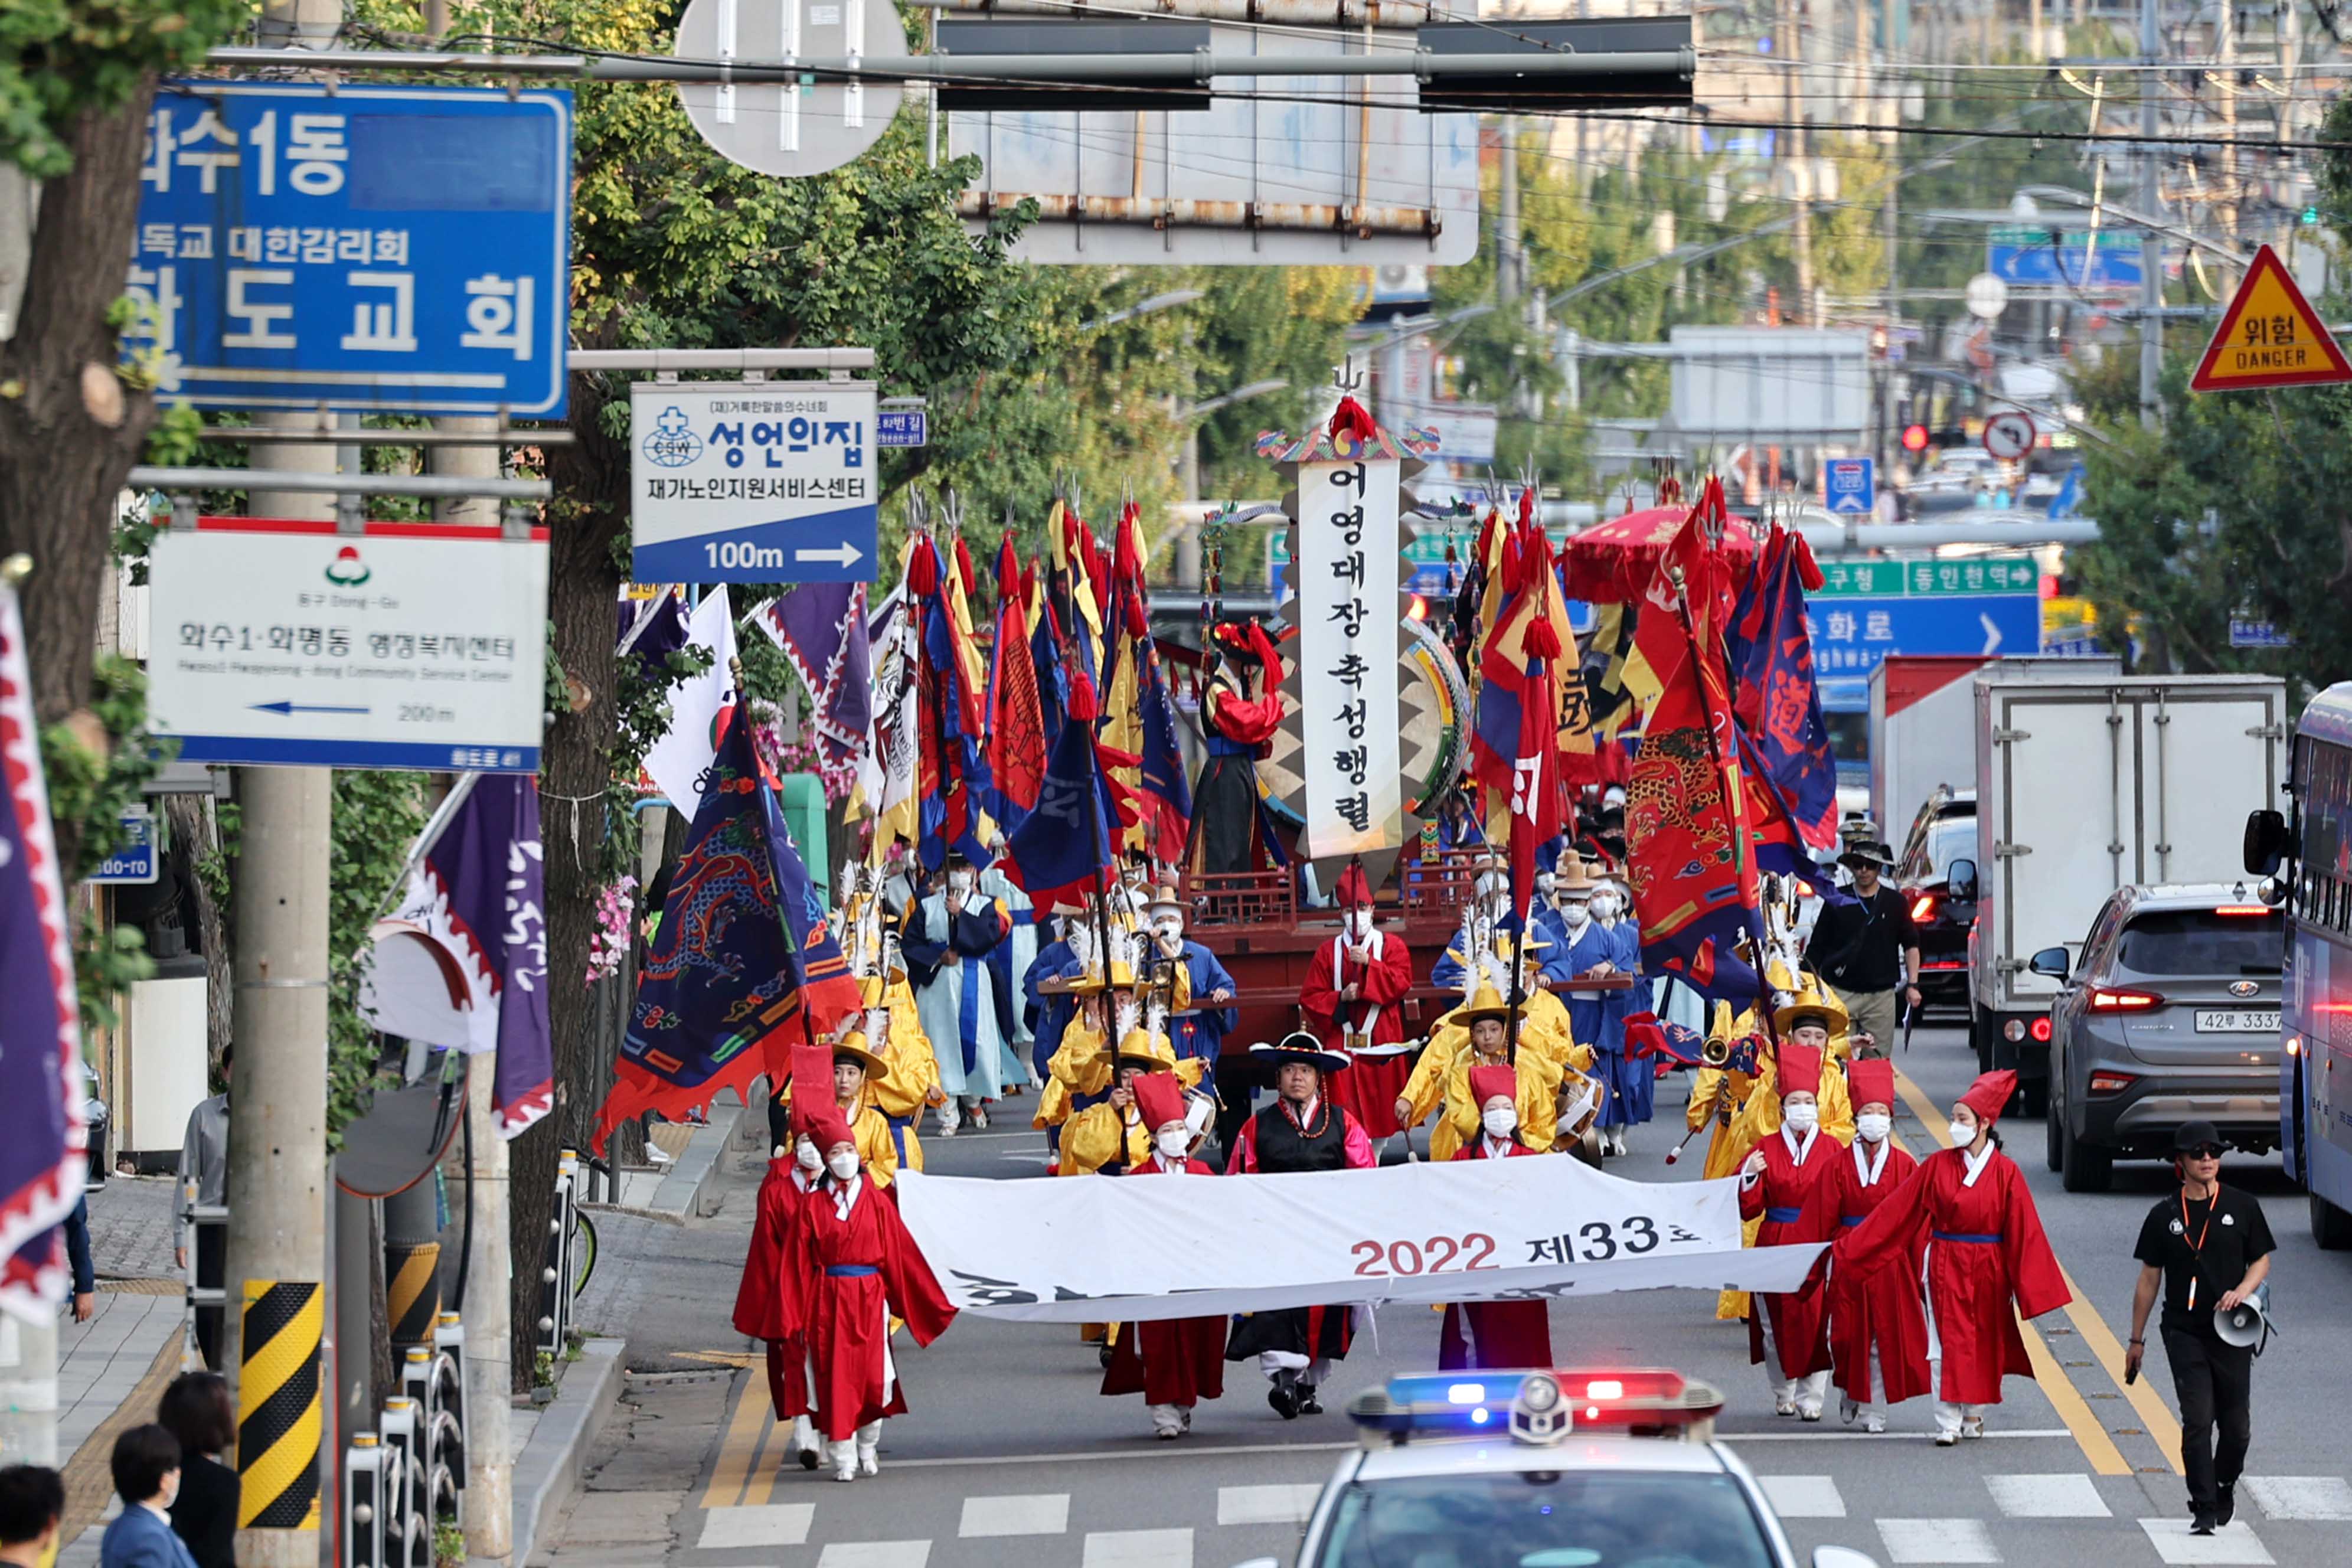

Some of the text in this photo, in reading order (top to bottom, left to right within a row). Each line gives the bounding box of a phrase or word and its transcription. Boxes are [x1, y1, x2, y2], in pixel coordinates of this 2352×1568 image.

[228, 226, 409, 266] 대한감리회
[2245, 315, 2295, 345] 위험
[2236, 349, 2307, 370] DANGER
[654, 442, 690, 454] CSW
[710, 417, 863, 468] 성언의집
[648, 478, 865, 499] 재가노인지원서비스센터
[705, 542, 783, 569] 100m
[1915, 563, 2008, 590] 동인천역
[368, 633, 514, 661] 행정복지센터
[348, 665, 416, 681] Community
[420, 667, 467, 680] Service
[471, 668, 512, 682] Center
[2243, 1014, 2282, 1028] 3337
[1351, 1232, 1500, 1276] 2022
